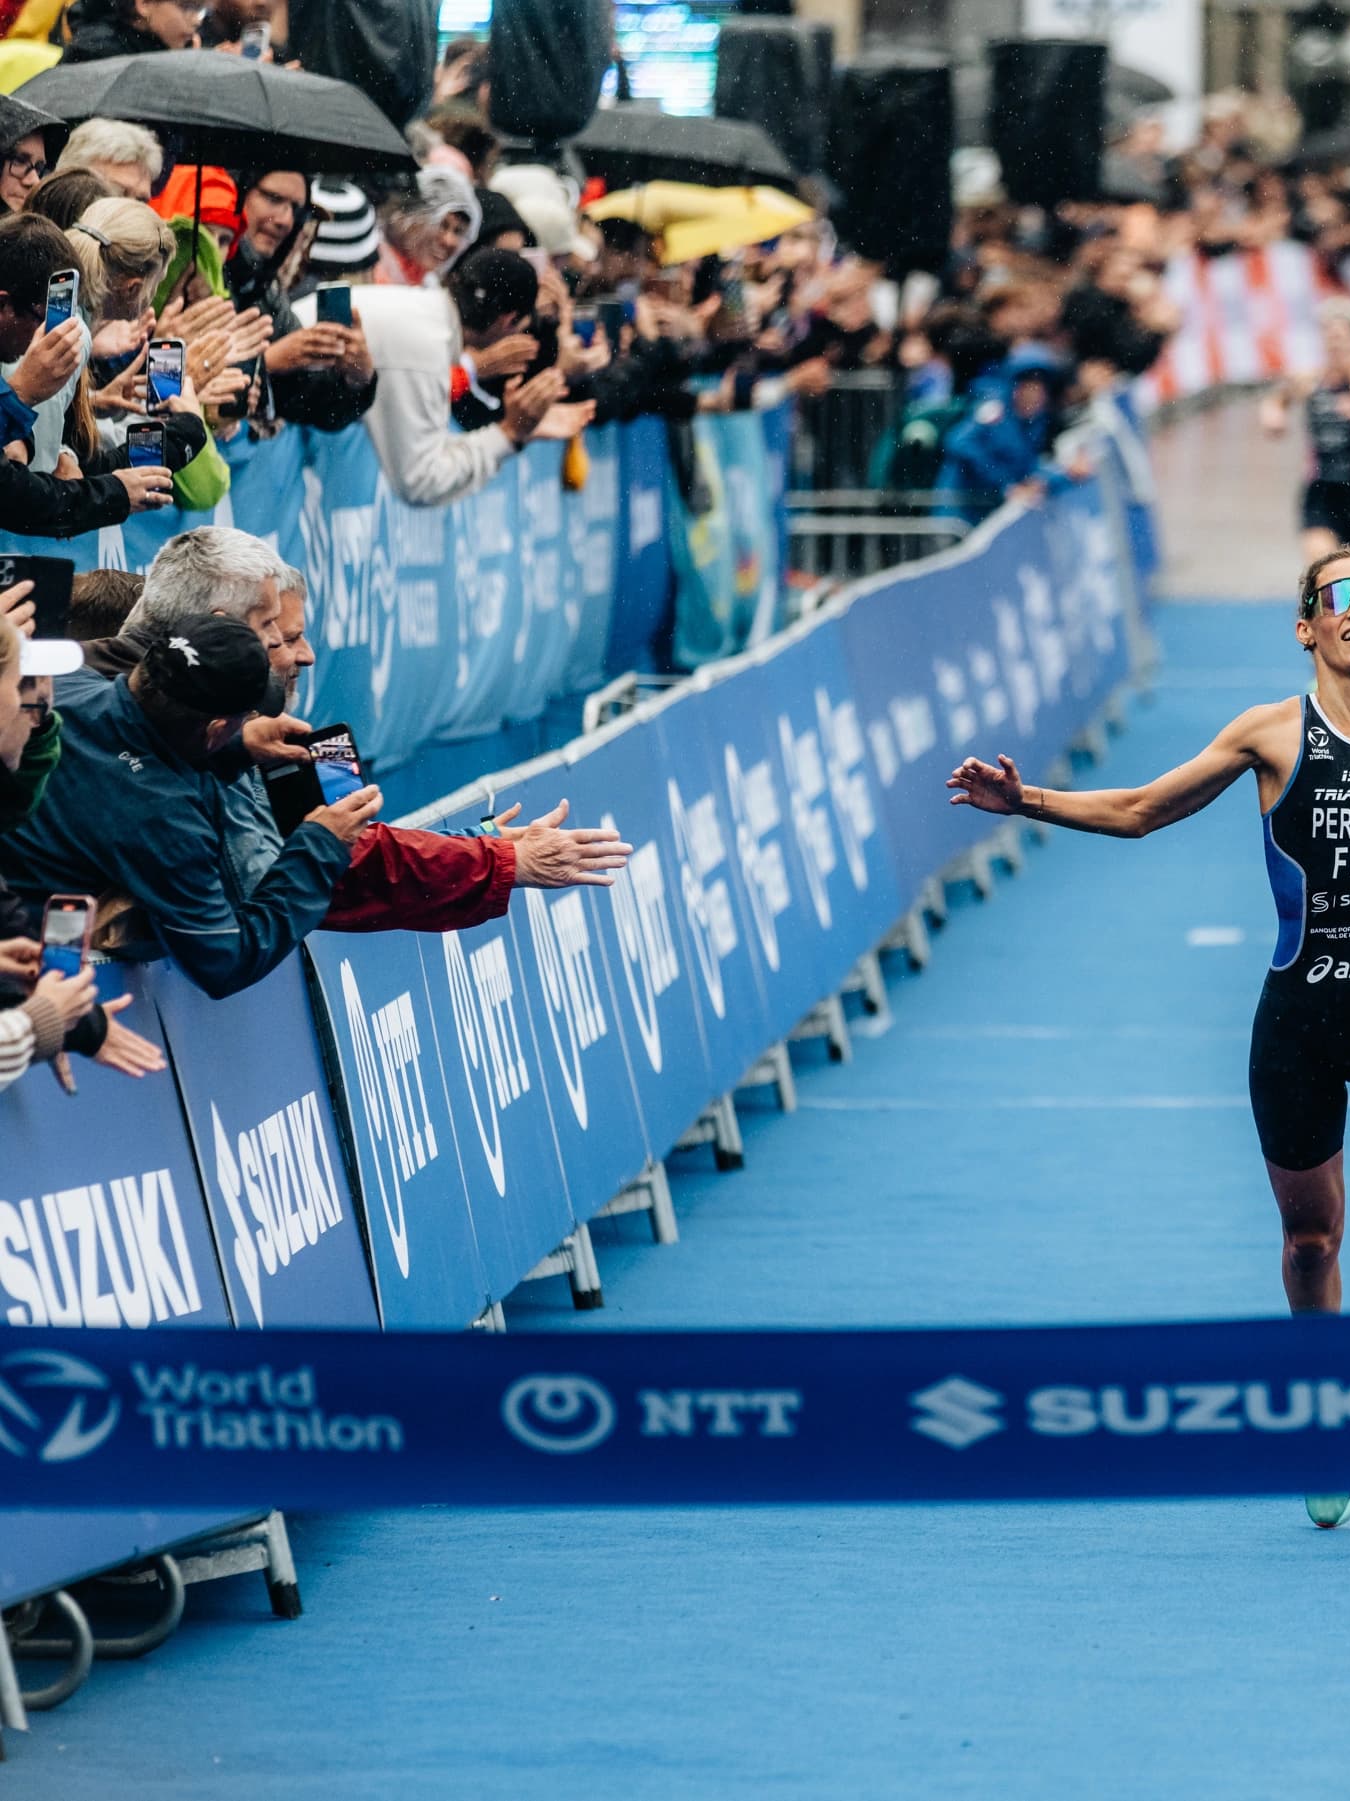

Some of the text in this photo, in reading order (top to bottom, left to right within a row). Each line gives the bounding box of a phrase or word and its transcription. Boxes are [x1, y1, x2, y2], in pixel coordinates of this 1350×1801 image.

[238, 1090, 343, 1276] SUZUKI
[0, 1168, 202, 1329] SUZUKI
[131, 1362, 316, 1407] World
[137, 1404, 404, 1452] Triathlon
[638, 1389, 802, 1437] NTT
